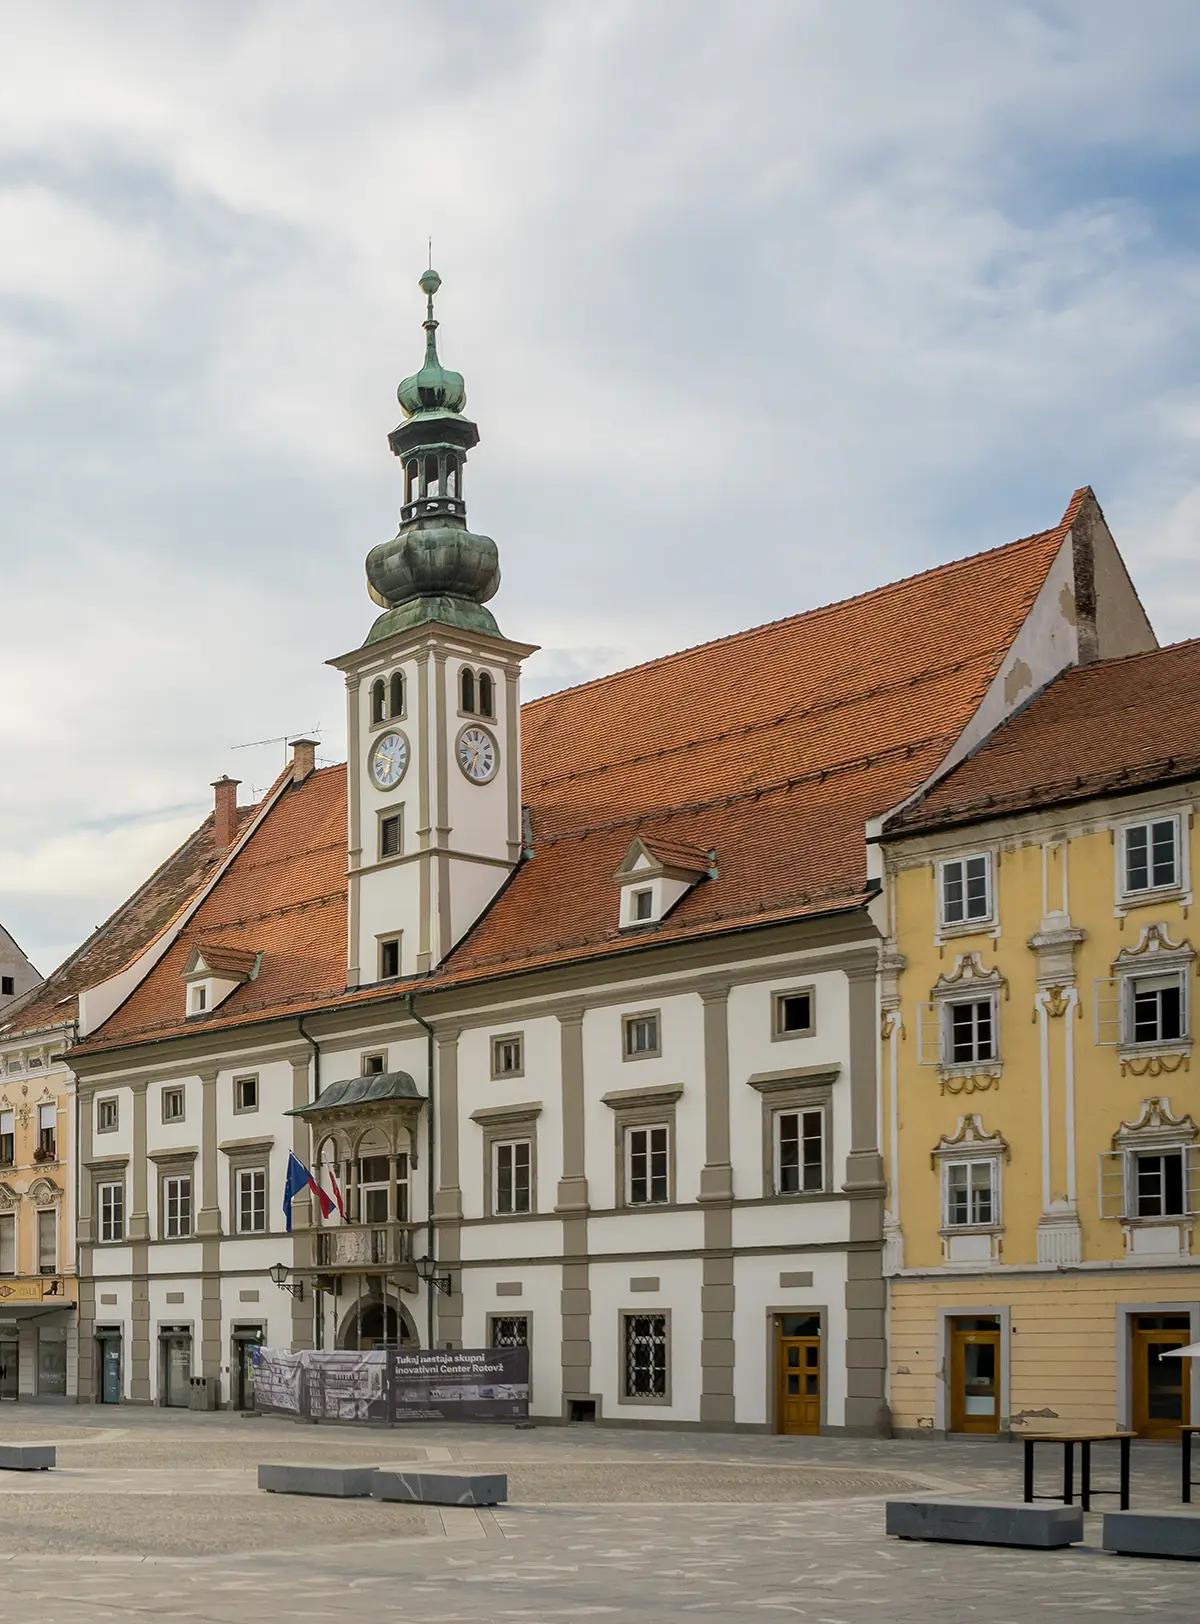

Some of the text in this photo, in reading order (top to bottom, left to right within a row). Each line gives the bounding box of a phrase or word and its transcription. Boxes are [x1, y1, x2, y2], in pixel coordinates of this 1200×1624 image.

[395, 1353, 485, 1365] Tukaj nastaja skupni
[395, 1363, 504, 1374] inovativni Center Rotovž
